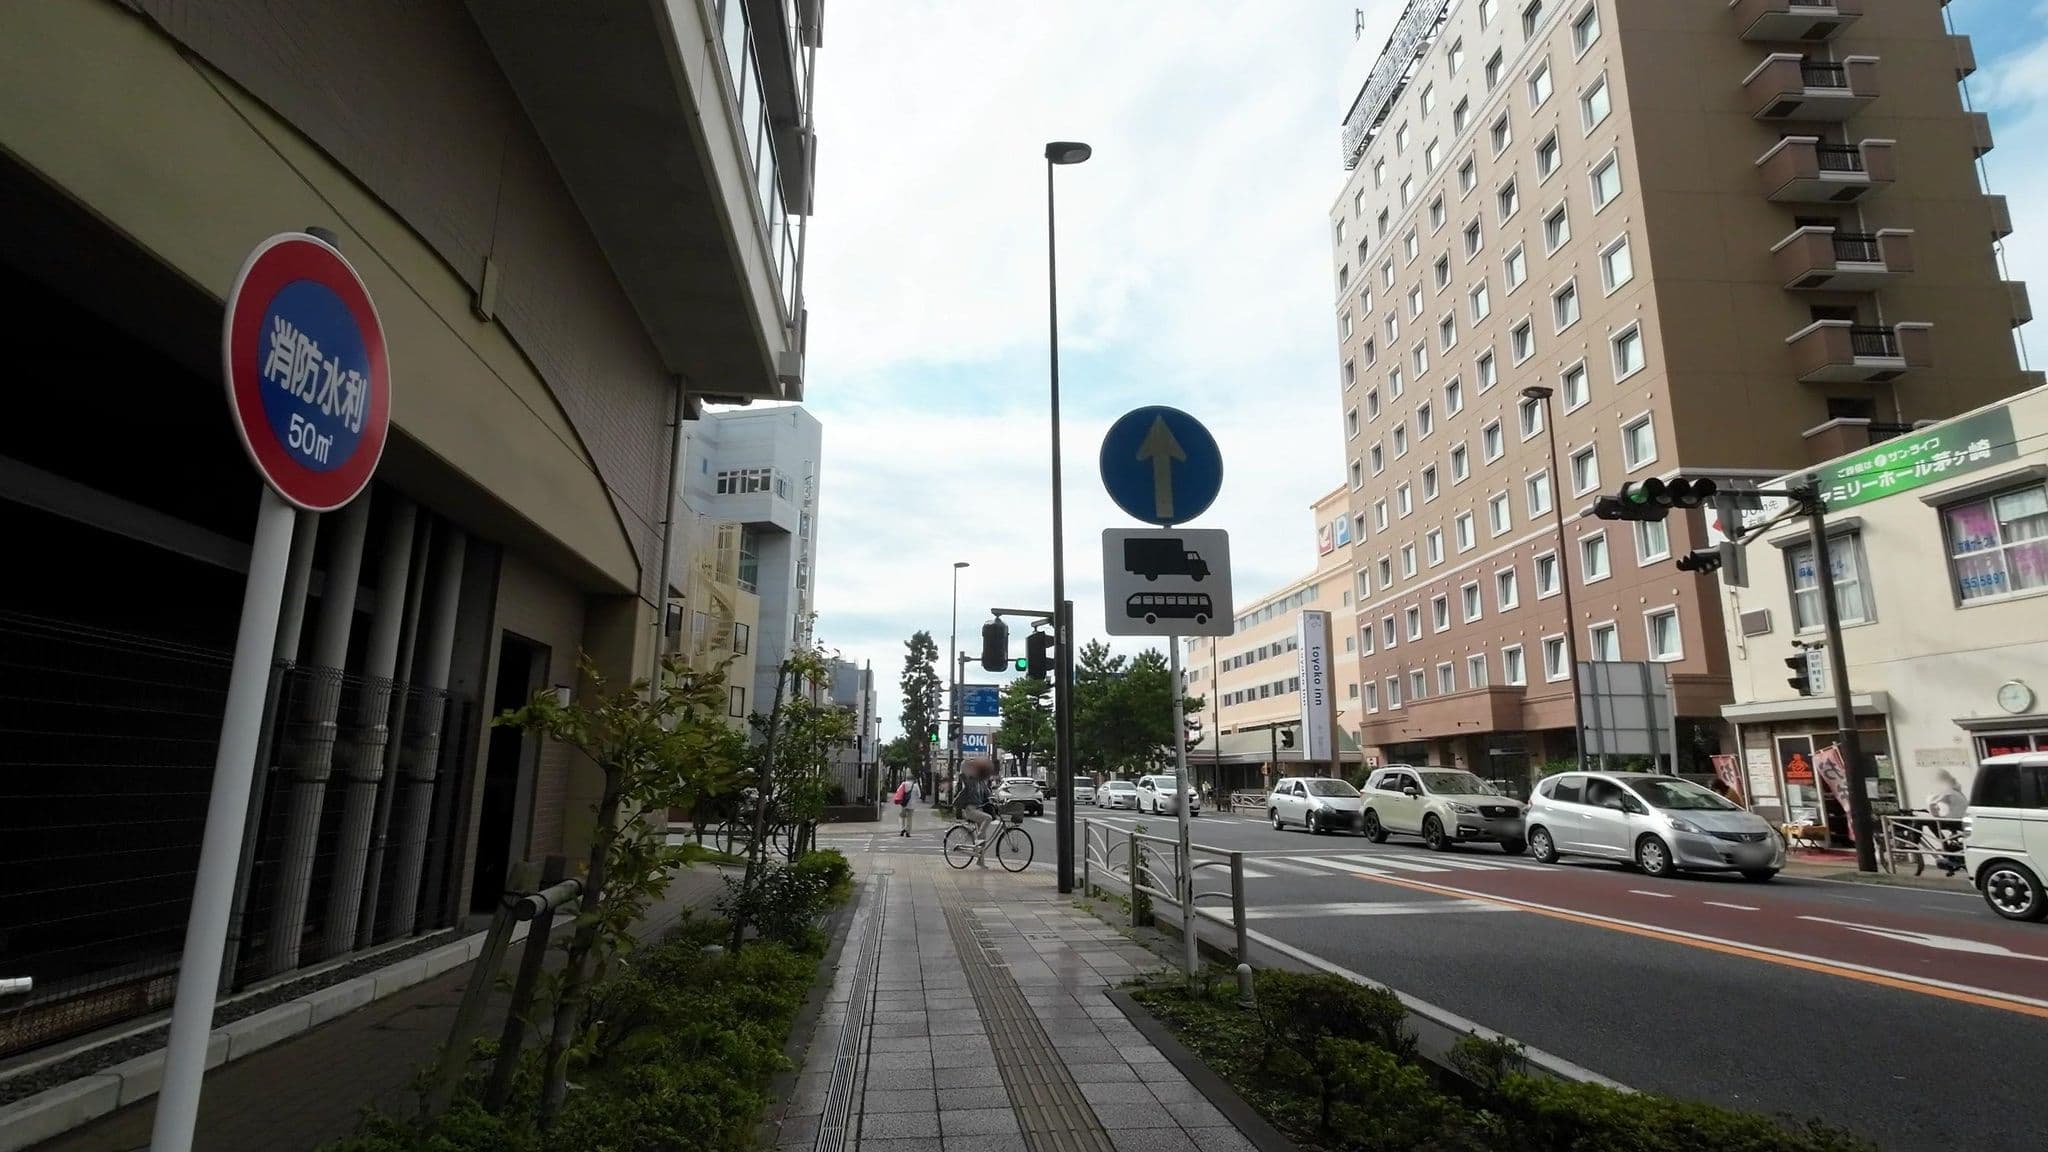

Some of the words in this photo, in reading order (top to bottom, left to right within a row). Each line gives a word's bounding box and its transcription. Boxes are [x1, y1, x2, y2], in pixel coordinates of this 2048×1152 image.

[264, 315, 368, 434] 消防水利
[1312, 646, 1323, 685] toyoko
